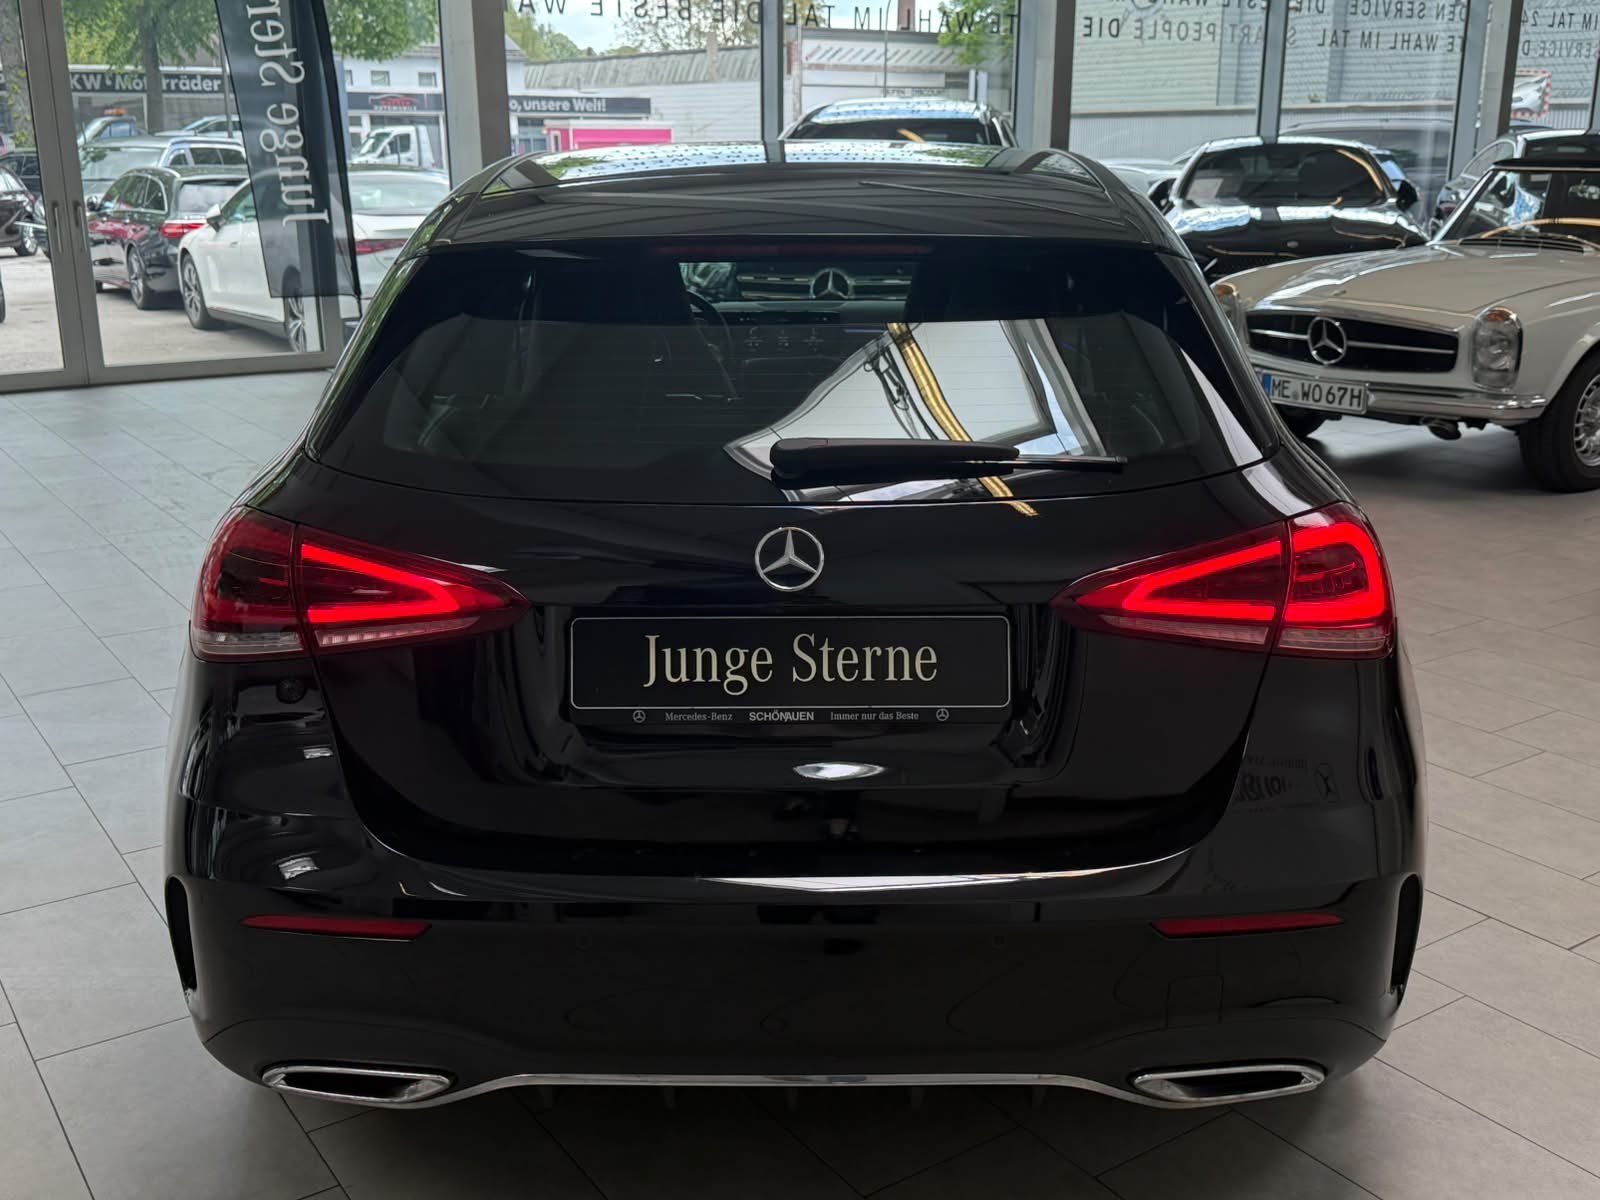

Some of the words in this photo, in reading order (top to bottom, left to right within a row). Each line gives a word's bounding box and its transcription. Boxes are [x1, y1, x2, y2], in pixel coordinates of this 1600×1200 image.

[523, 100, 570, 111] unsere
[572, 98, 606, 112] Welt!
[1272, 378, 1291, 399] ME
[643, 635, 773, 696] Junge
[792, 633, 938, 682] Sterne
[665, 711, 733, 722] Mercedes-Benz
[830, 712, 859, 721] Immer
[861, 713, 876, 721] nur
[878, 711, 894, 721] das
[896, 711, 919, 721] Beste
